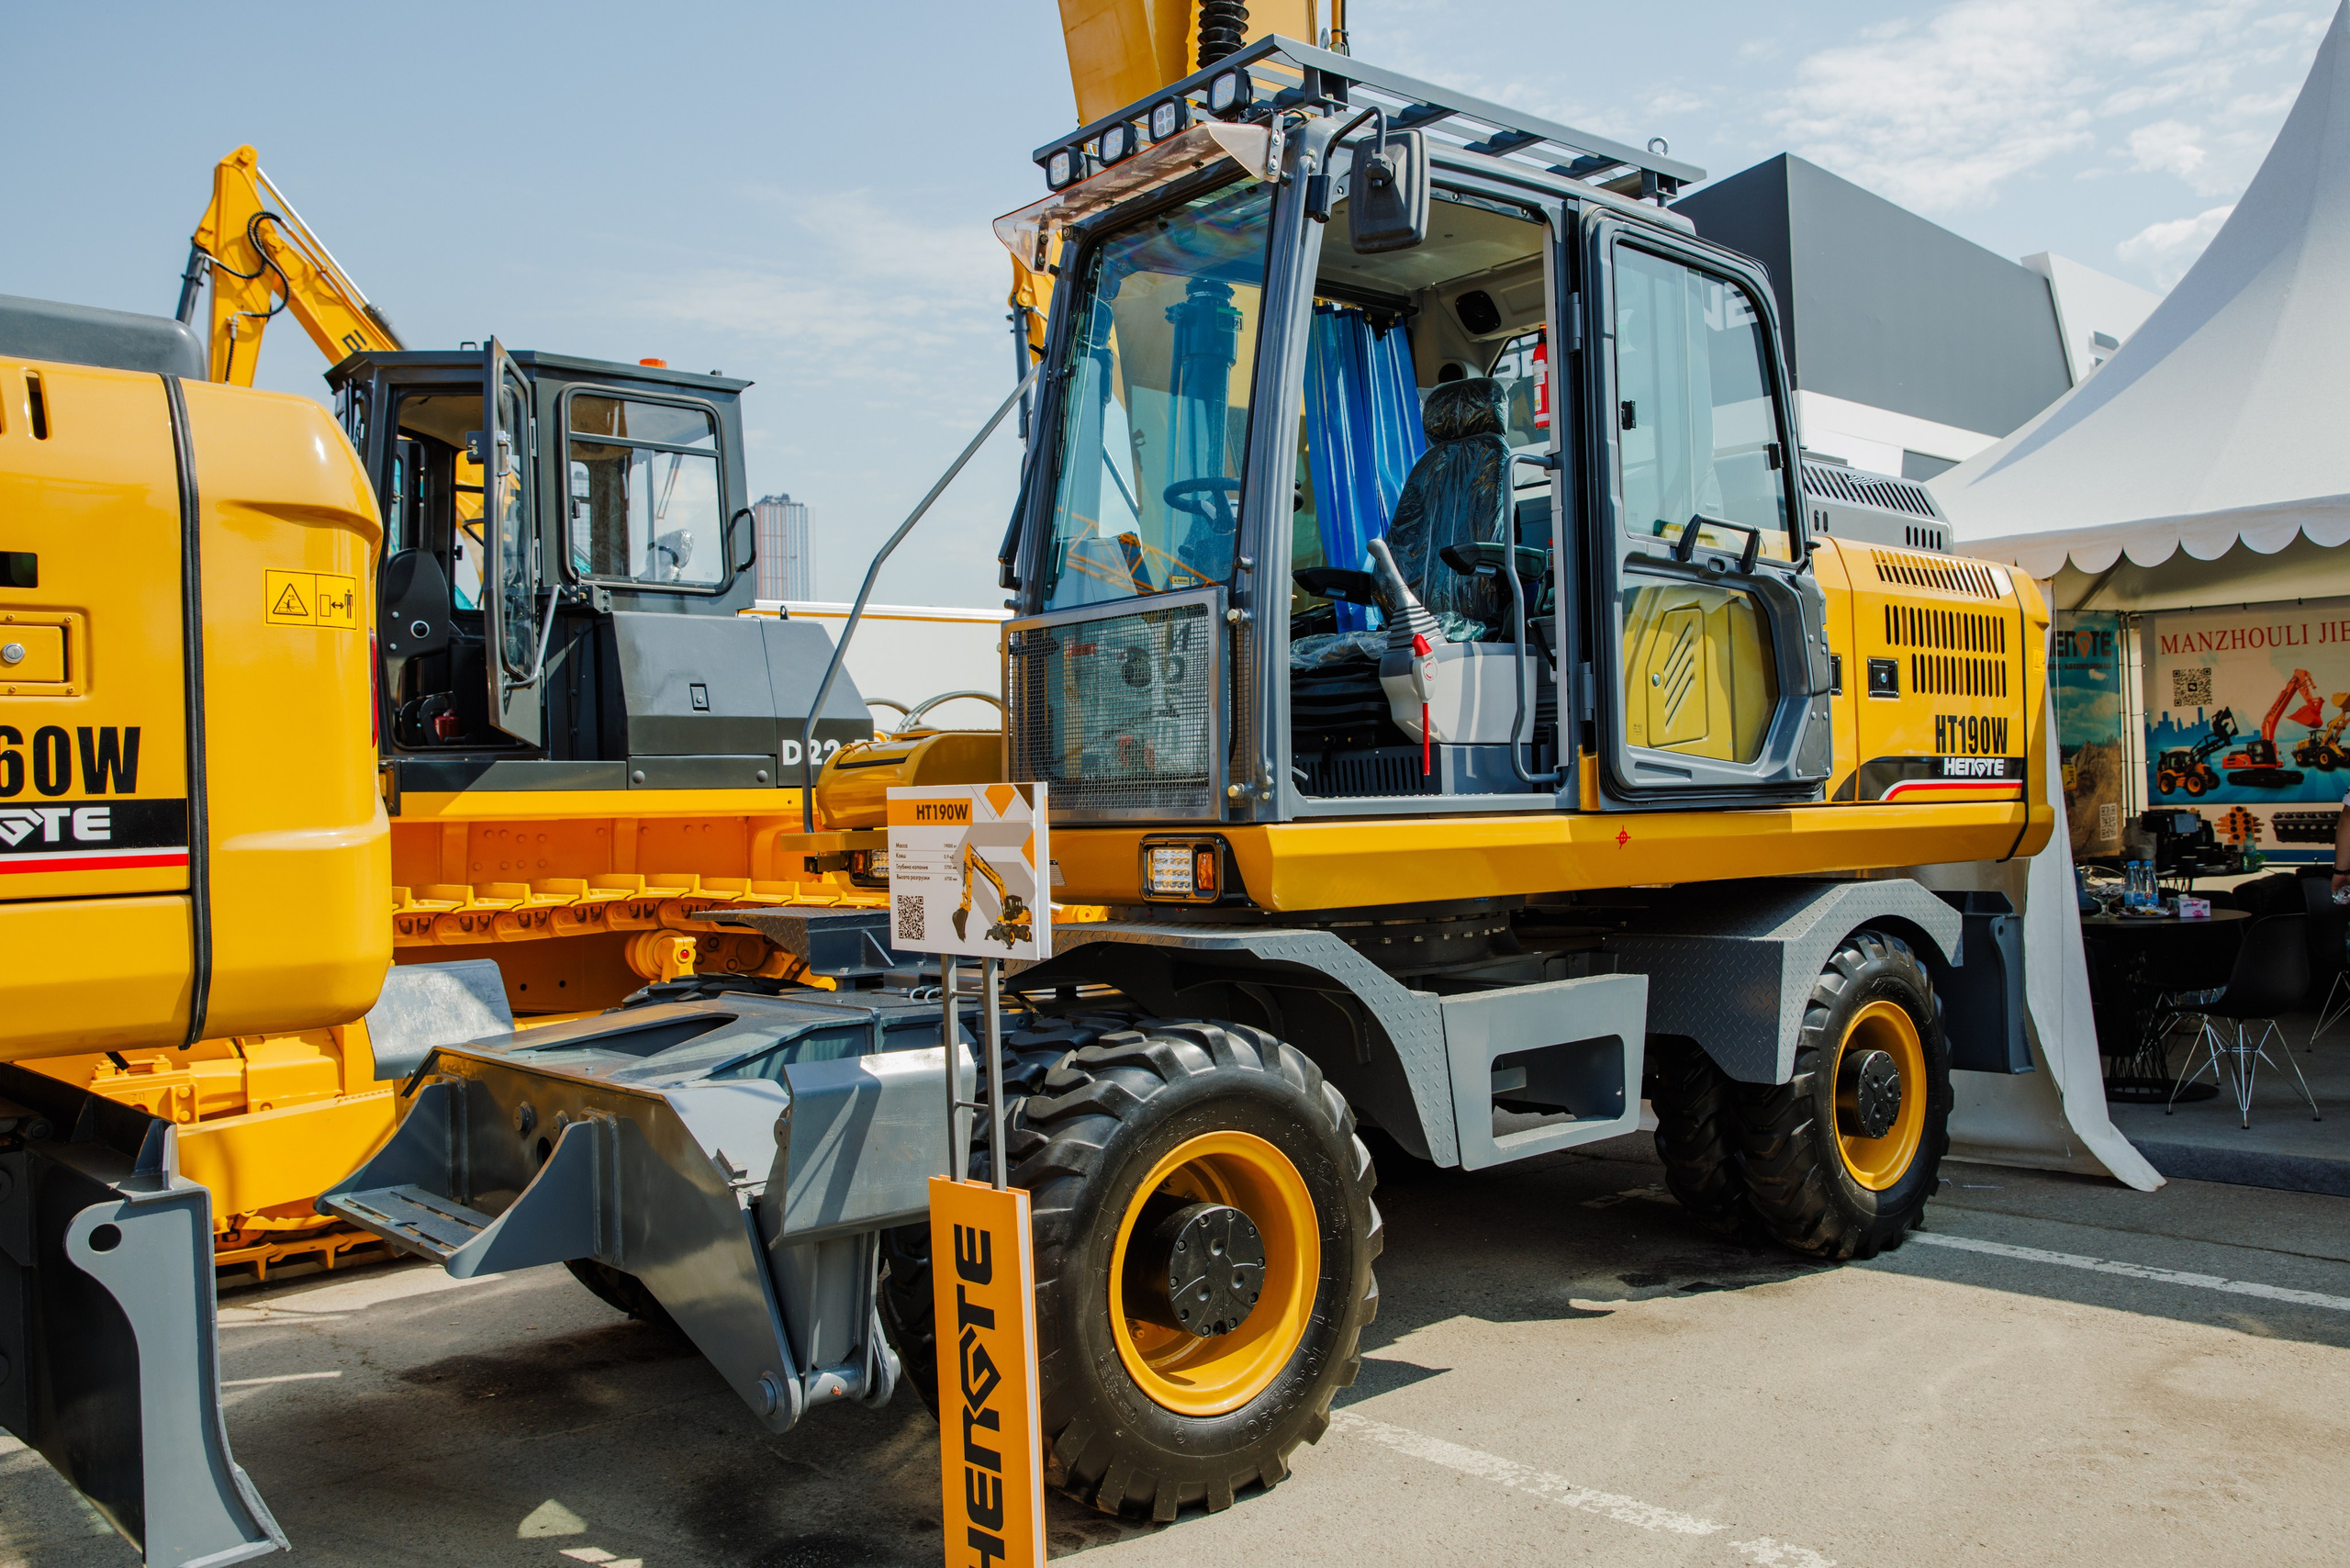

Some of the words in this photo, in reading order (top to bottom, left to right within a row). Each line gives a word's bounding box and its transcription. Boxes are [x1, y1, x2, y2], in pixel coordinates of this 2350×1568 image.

[2050, 631, 2111, 660] ENGTE
[2160, 623, 2310, 655] MANZHOULI
[2319, 620, 2350, 644] JIE
[1935, 714, 2008, 755] HT190W
[0, 725, 141, 798] 60W
[782, 739, 868, 766] D22
[916, 804, 968, 820] HT190W
[1246, 1347, 1327, 1440] 10.00-20
